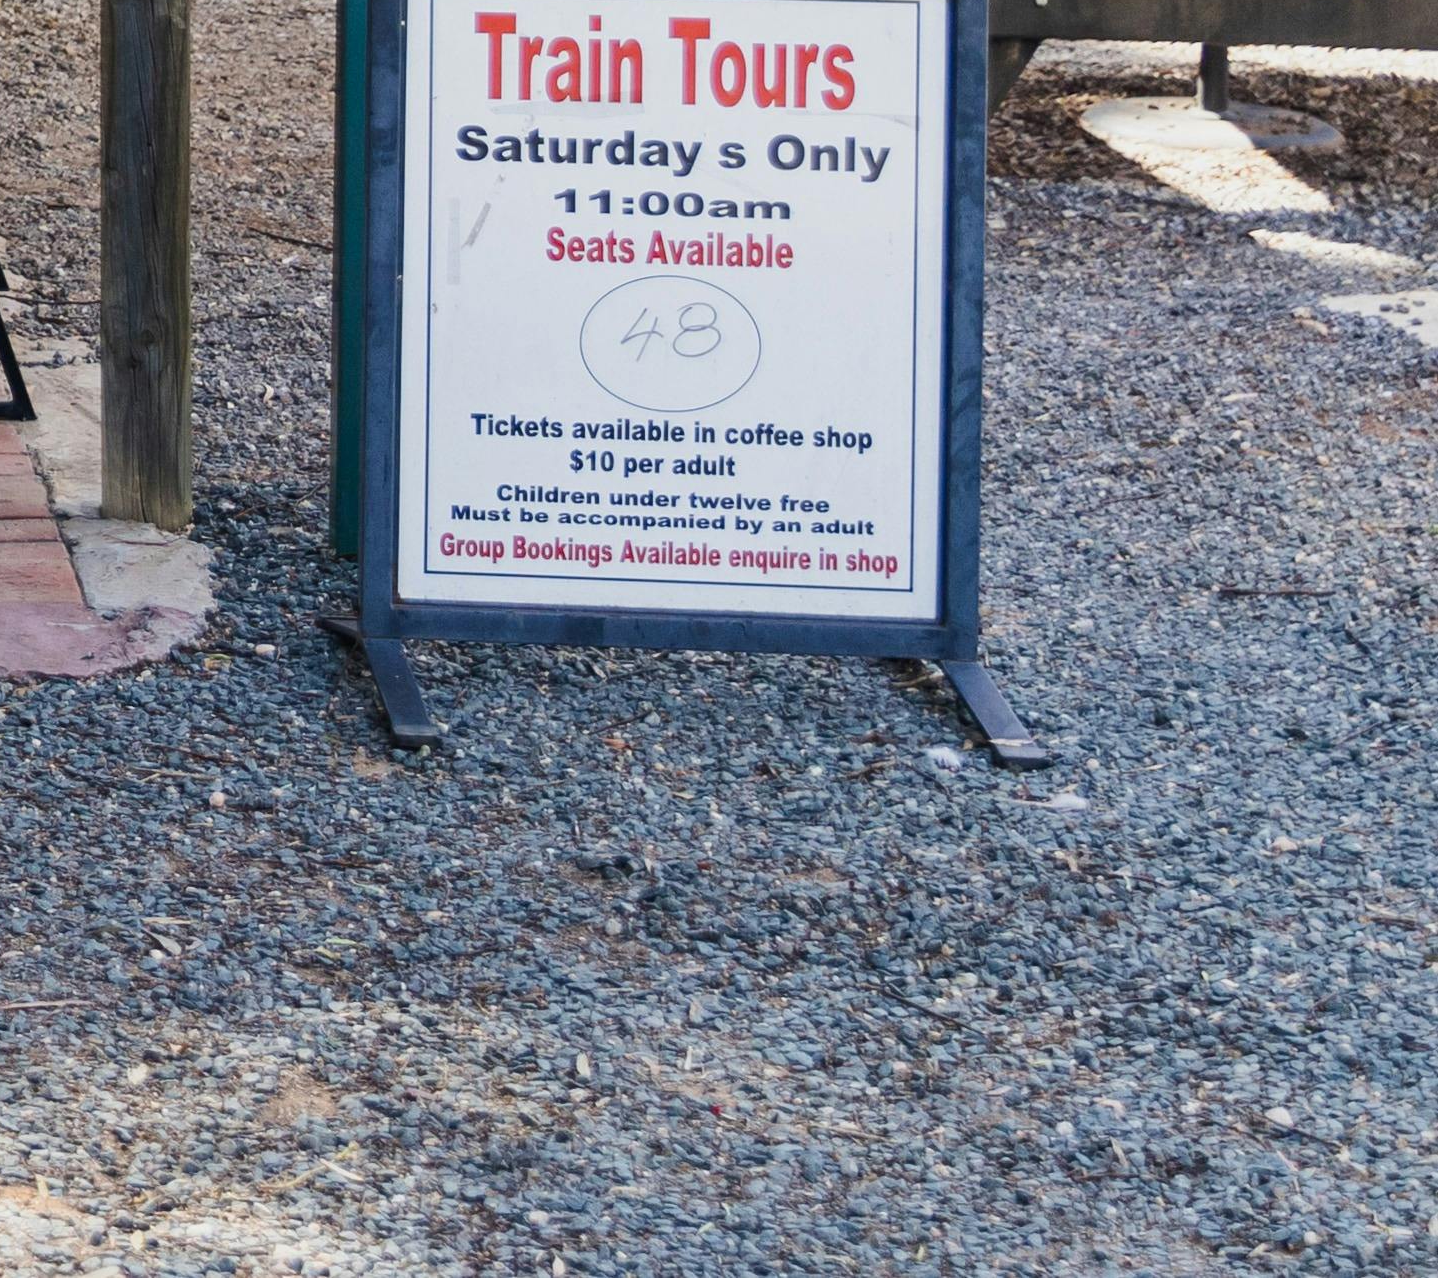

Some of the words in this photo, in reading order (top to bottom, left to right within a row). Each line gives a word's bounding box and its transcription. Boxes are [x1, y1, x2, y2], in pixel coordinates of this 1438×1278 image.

[474, 12, 642, 104] Train
[669, 17, 856, 110] Tours
[455, 125, 702, 177] Saturday
[767, 133, 891, 183] Only
[554, 188, 791, 219] 11:00am
[546, 226, 635, 264] Seats
[646, 230, 794, 268] Available
[620, 302, 722, 362] 48
[471, 413, 563, 438] Tickets
[572, 419, 685, 442] available
[694, 421, 716, 443] in
[724, 423, 804, 446] coffee
[812, 426, 872, 454] shop
[569, 449, 615, 474] $10
[624, 455, 664, 477] per
[672, 455, 736, 477] adult
[496, 485, 600, 506] Children
[609, 490, 680, 509] under
[689, 493, 772, 512] twelve
[779, 495, 830, 514] free
[451, 505, 511, 523] Must
[520, 507, 550, 524] be
[558, 509, 726, 532] accompanied
[735, 514, 763, 534] by
[772, 519, 802, 534] an
[810, 519, 875, 536] adult
[439, 533, 505, 563] Group
[512, 536, 613, 568] Bookings
[620, 539, 721, 568] Available
[729, 546, 811, 575] enquire
[819, 547, 838, 572] in
[845, 548, 899, 579] shop
